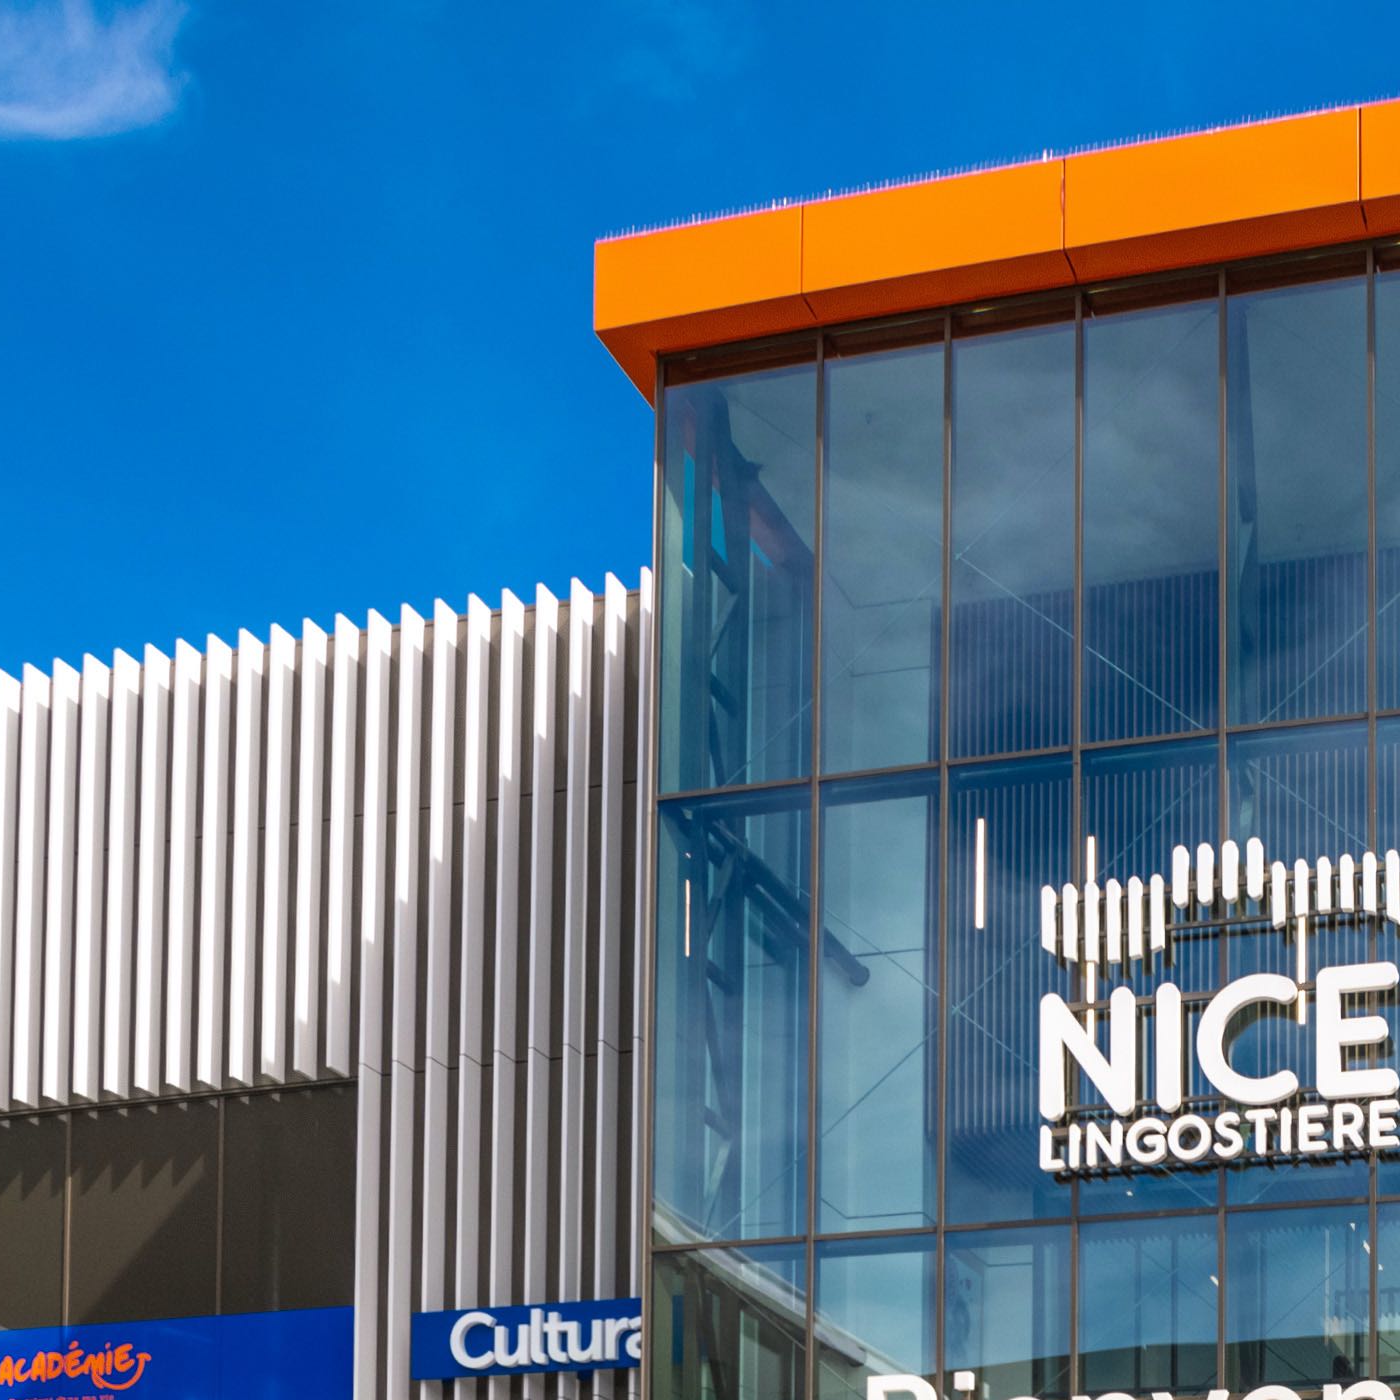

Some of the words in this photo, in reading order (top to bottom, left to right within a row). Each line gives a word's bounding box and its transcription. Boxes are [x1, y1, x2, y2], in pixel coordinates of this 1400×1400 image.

[1039, 962, 1399, 1122] NICE
[1039, 1098, 1400, 1173] LINGOSTIERE
[449, 1307, 642, 1370] Cultura
